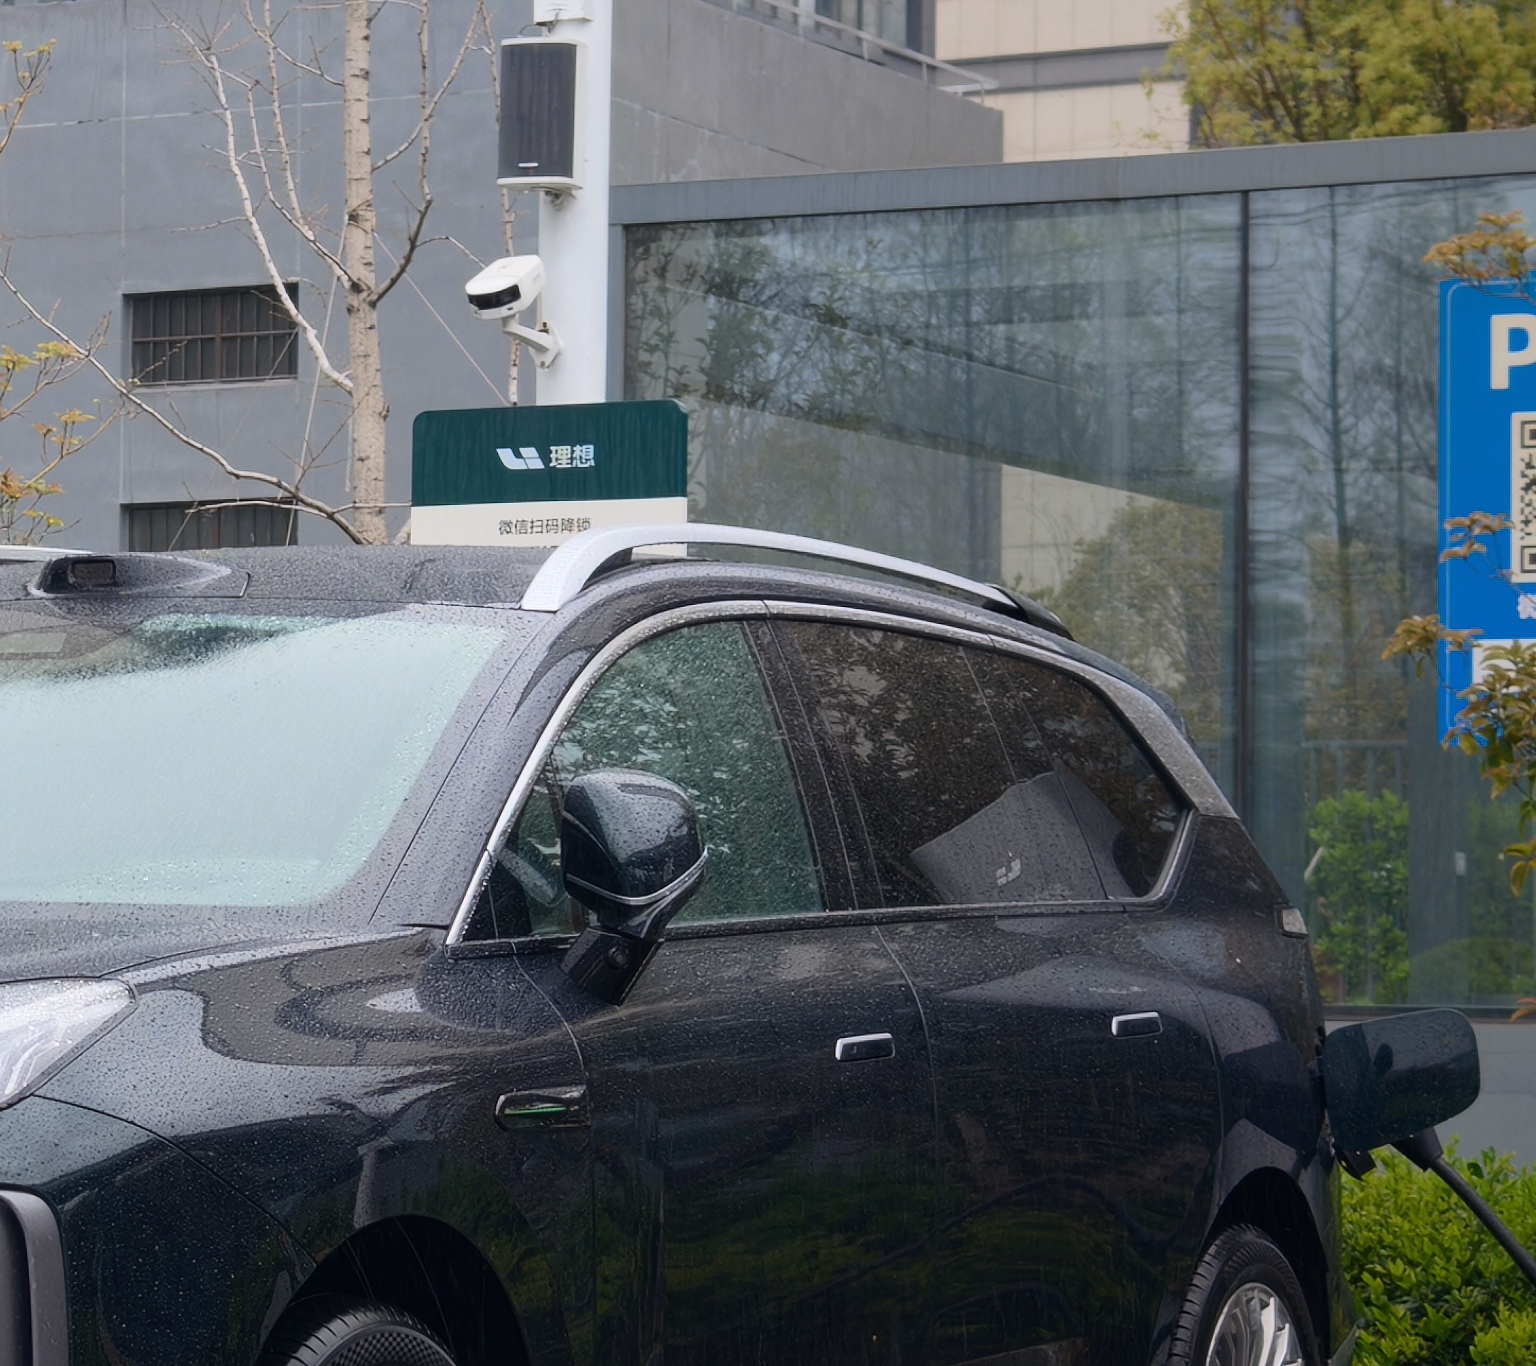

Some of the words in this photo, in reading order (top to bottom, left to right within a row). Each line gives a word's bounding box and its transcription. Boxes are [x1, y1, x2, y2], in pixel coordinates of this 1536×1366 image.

[549, 444, 595, 468] 理想
[499, 517, 591, 535] 微信扫码降锁
